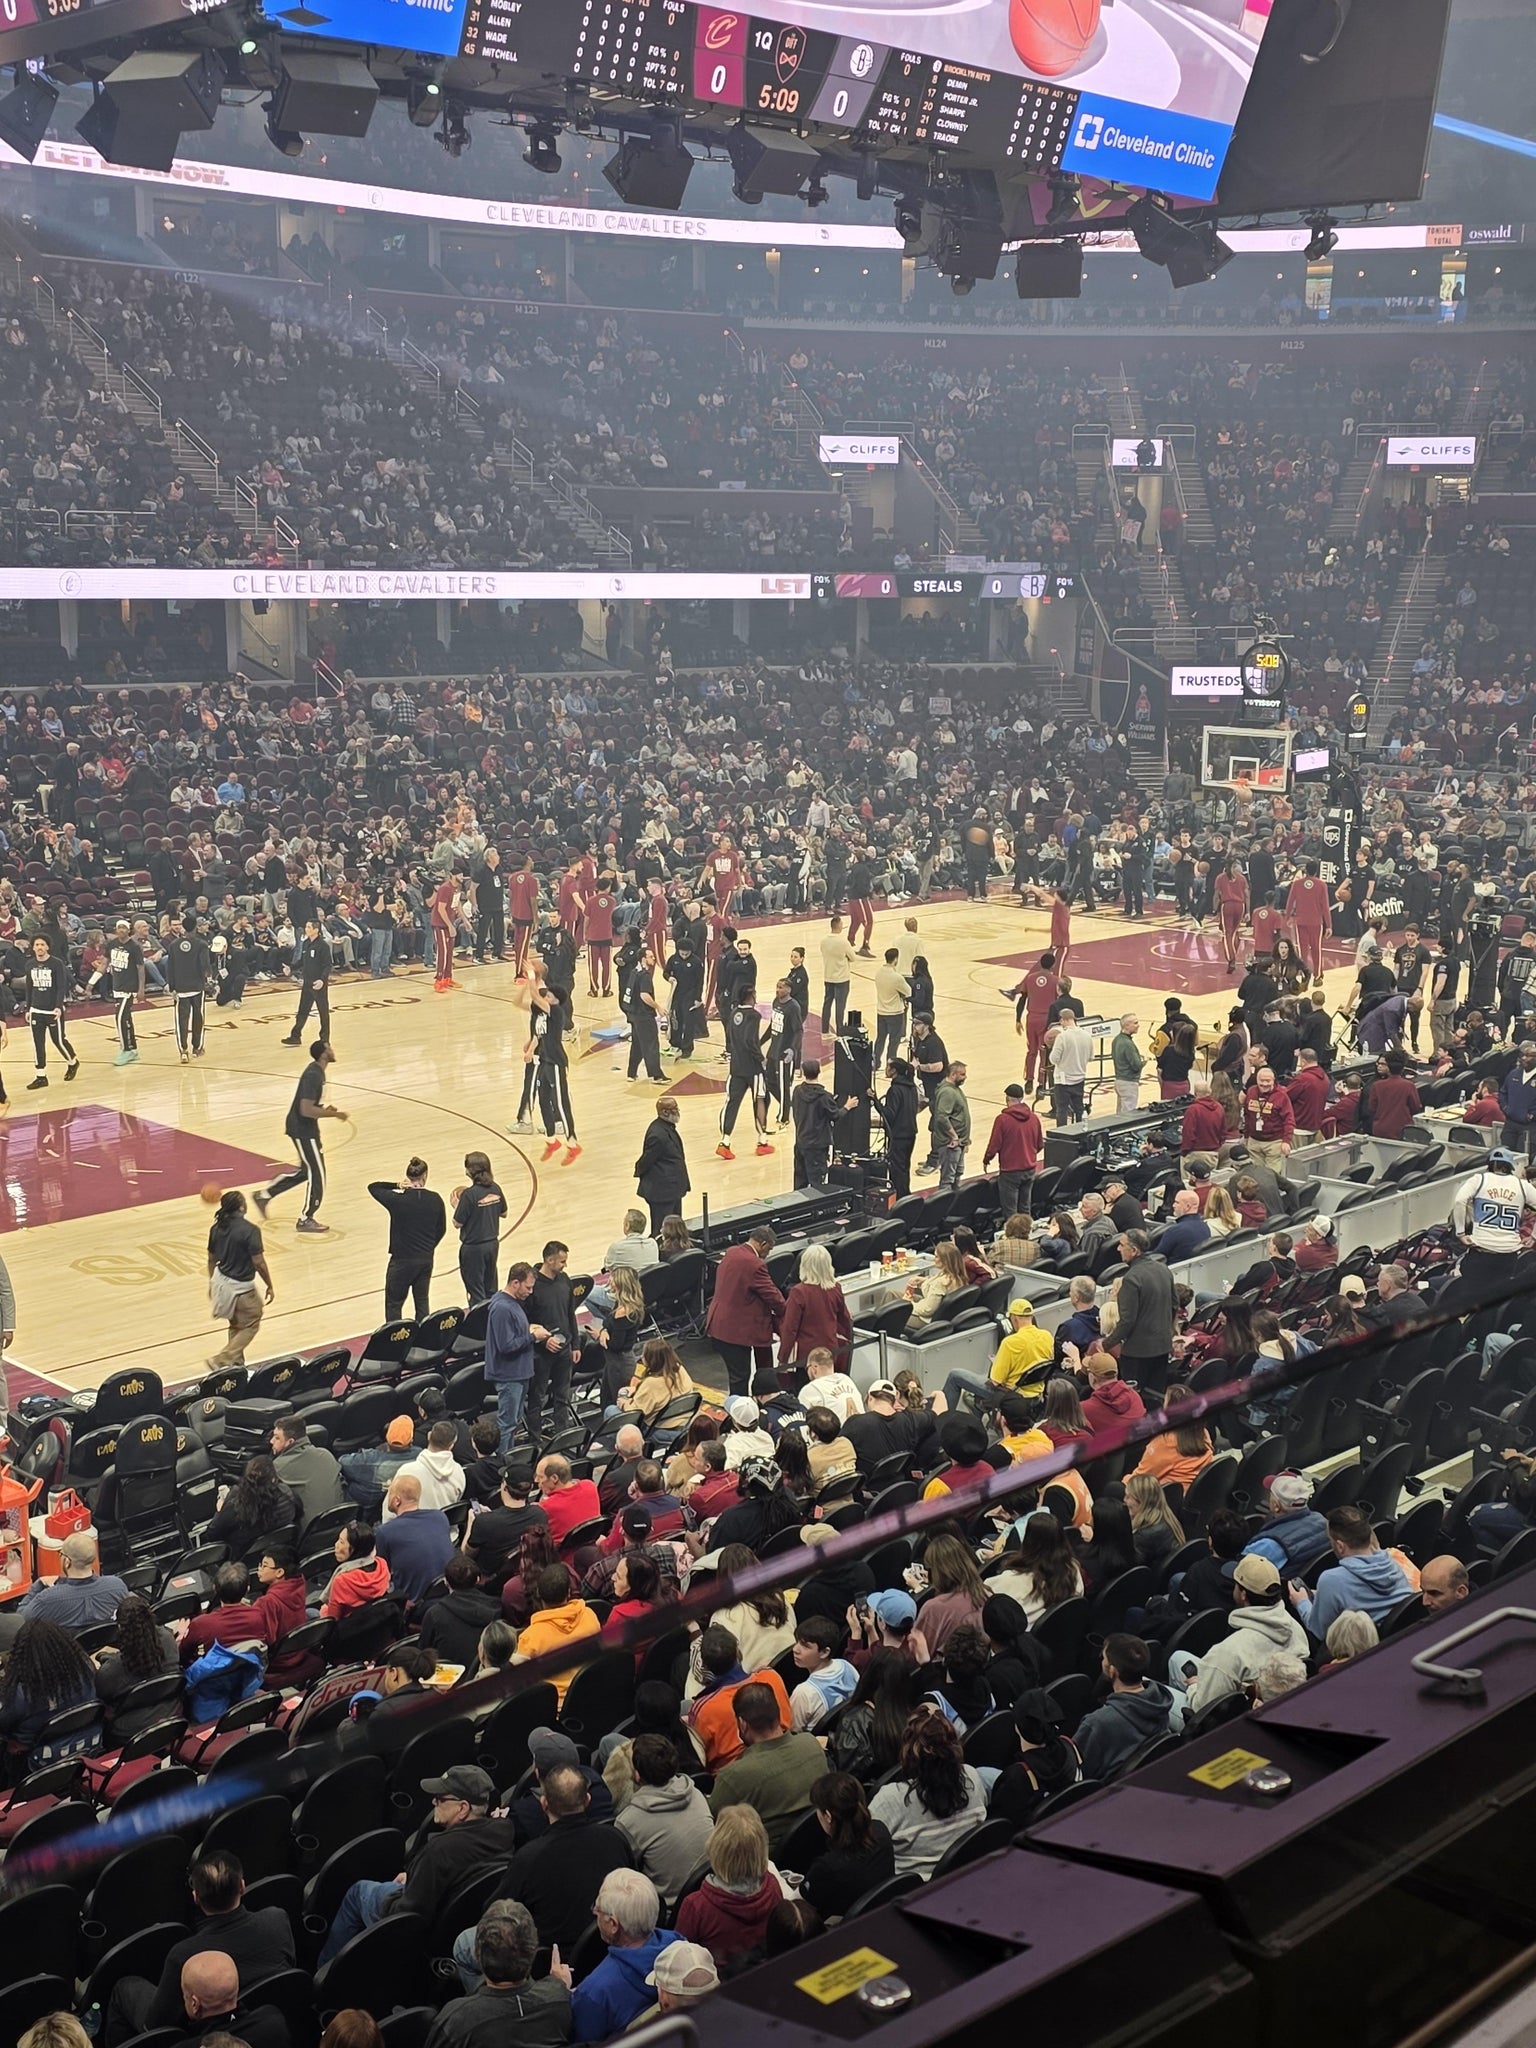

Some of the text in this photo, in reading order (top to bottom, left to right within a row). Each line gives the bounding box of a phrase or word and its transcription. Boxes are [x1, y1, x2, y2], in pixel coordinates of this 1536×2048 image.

[586, 0, 644, 21] 0 0 0 0
[663, 0, 685, 13] FOULS
[583, 16, 589, 26] 0
[602, 20, 608, 30] 0
[619, 23, 625, 33] 0
[635, 26, 641, 36] 0
[668, 12, 675, 25] 0
[470, 10, 638, 52] 31 ALLEN 0 0 0 0
[466, 26, 635, 67] 32 WADE 0 0 0 0
[755, 31, 773, 51] 1Q
[464, 42, 632, 82] 45 MITCHELL 0 0 0 0
[673, 50, 680, 61] 0
[900, 52, 922, 65] FOULS
[670, 66, 677, 77] 0
[904, 64, 911, 76] 0
[943, 64, 975, 79] BROOKLYN
[643, 77, 656, 89] TOL
[710, 65, 727, 94] 0
[758, 84, 800, 113] 5:09
[932, 74, 938, 84] 8
[1021, 95, 1027, 104] 0
[1036, 98, 1042, 107] 0
[1050, 101, 1056, 110] 0
[1067, 105, 1073, 114] 0
[1022, 83, 1078, 102] PTS REB AST FLS
[833, 90, 849, 118] 0
[904, 98, 910, 107] 0
[927, 88, 936, 98] 17
[943, 92, 968, 105] PORTER
[1017, 107, 1023, 116] 0
[1032, 111, 1038, 120] 0
[1047, 114, 1053, 123] 0
[1063, 118, 1069, 127] 0
[901, 111, 906, 121] 0
[923, 101, 1065, 139] 20 SHARPE 0 0 0 0
[868, 119, 881, 130] TOL
[920, 115, 1062, 152] 21 CLOWNEY 0 0 0 0
[915, 128, 927, 137] 88
[1007, 146, 1013, 155] 0
[1021, 149, 1027, 158] 0
[1036, 152, 1042, 161] 0
[1052, 156, 1058, 165] 0
[1103, 126, 1215, 169] Cleveland Clinic
[45, 151, 92, 167] LET
[486, 204, 707, 236] CLEVELAND CAVALIERS
[1427, 226, 1461, 234] TONIGHT'S
[1469, 224, 1512, 239] oswald
[1433, 237, 1452, 245] TOTAL
[924, 339, 947, 349] M124
[1280, 340, 1305, 350] M125
[849, 445, 895, 455] CLIFFS
[1420, 445, 1471, 456] CLIFFS
[233, 574, 497, 595] CLEVELAND CAVALIERS
[761, 578, 809, 594] LET
[881, 580, 890, 594] 0
[913, 580, 962, 593] STEALS
[991, 580, 1002, 594] 0
[817, 588, 825, 597] 0
[1058, 588, 1066, 599] 0
[1255, 654, 1280, 668] 5:08
[1254, 699, 1282, 708] TISSOT
[1487, 1187, 1516, 1202] PRICE
[1479, 1202, 1520, 1232] 25
[119, 1378, 145, 1397] CAVS
[140, 1423, 164, 1442] CAVS
